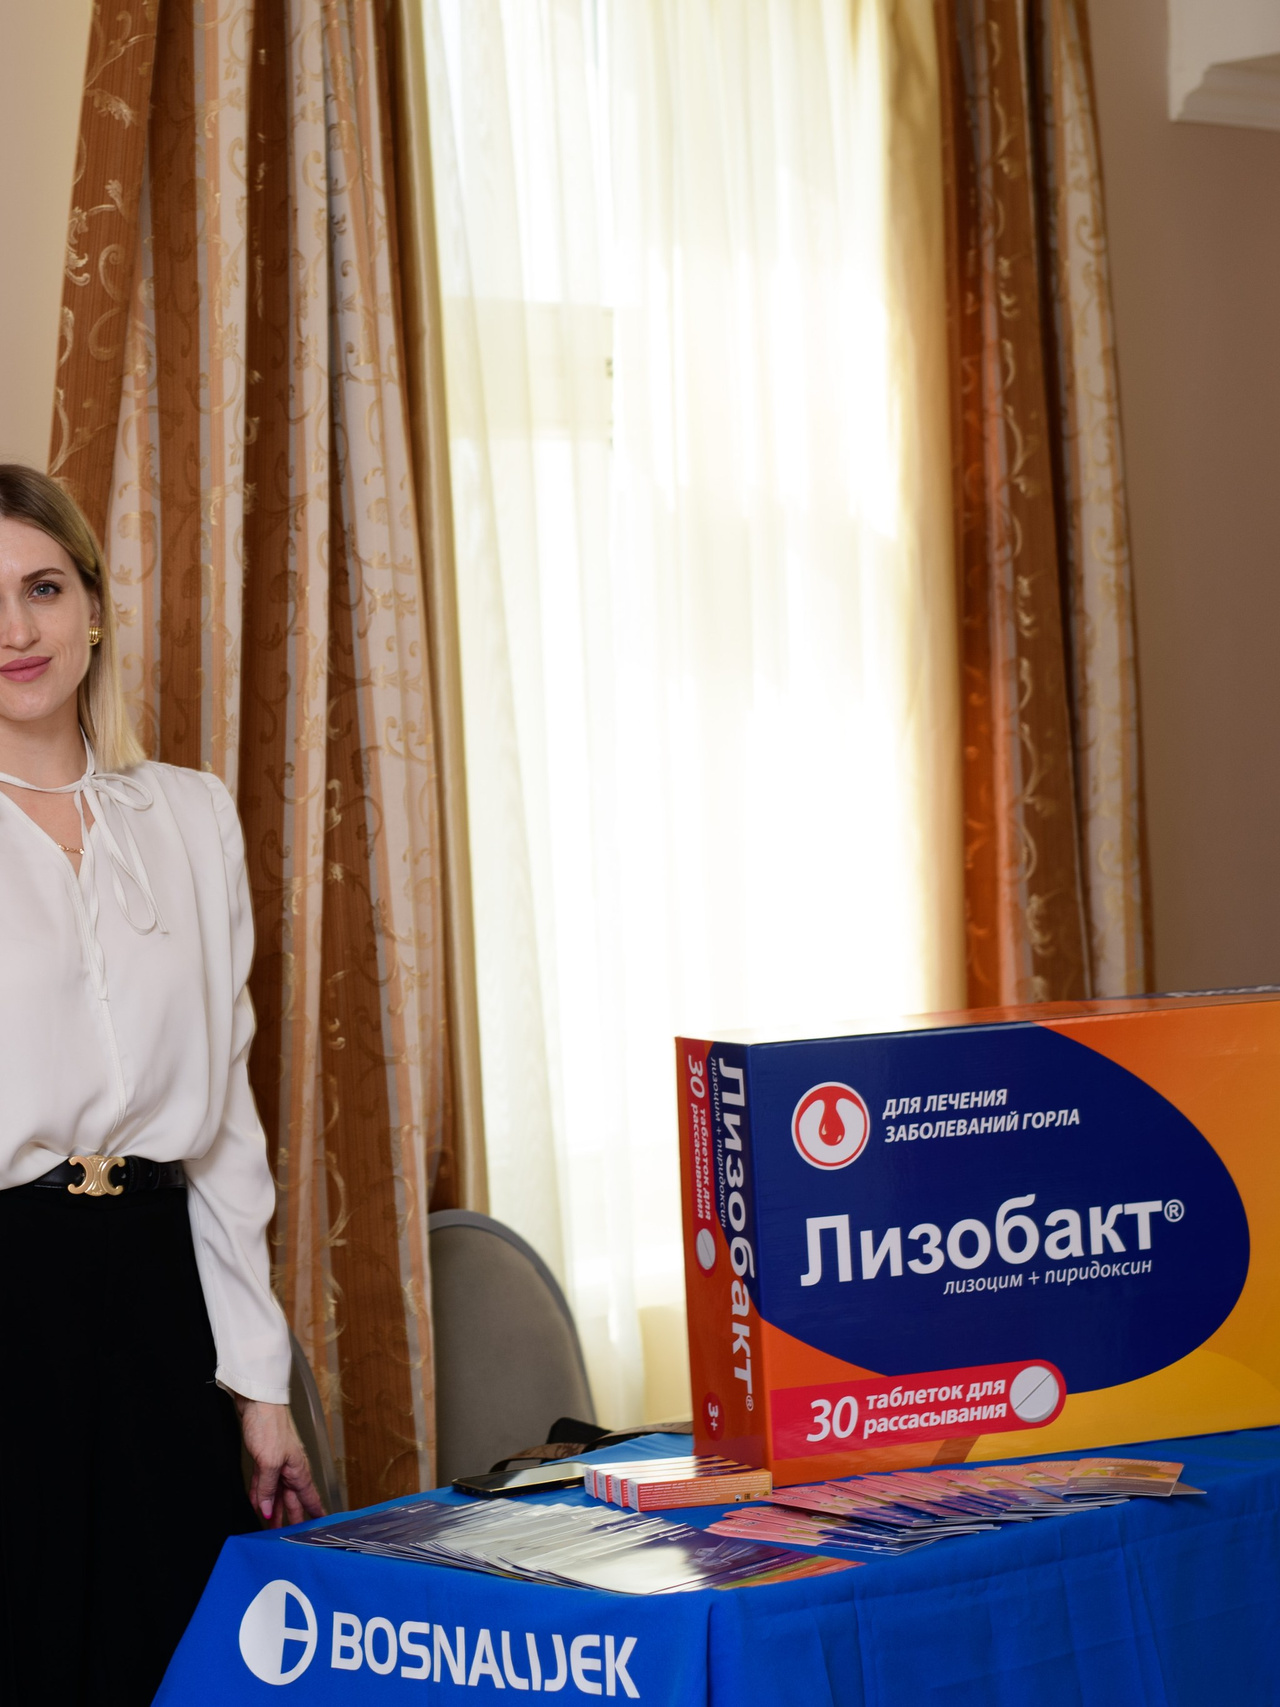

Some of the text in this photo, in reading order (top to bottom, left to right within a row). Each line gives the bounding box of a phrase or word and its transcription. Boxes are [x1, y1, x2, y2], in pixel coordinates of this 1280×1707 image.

[688, 1055, 712, 1221] 30 таблеток для
[710, 1056, 721, 1122] лизоцим
[718, 1139, 727, 1228] пиридоксин
[882, 1088, 1008, 1120] ДЛЯ ЛЕЧЕНИЯ
[884, 1108, 1080, 1144] ЗАБОЛЕВАНИЙ ГОРЛА
[691, 1103, 704, 1219] рассасывания
[719, 1057, 755, 1411] Лизобакт®
[800, 1193, 1185, 1287] Лизобакт®
[943, 1259, 1152, 1295] лизоцим + пиридоксин
[707, 1402, 719, 1431] 3+
[806, 1379, 1007, 1443] 30 таблеток для
[862, 1402, 1007, 1440] рассасывания
[331, 1611, 640, 1699] BOSNALIJEK
